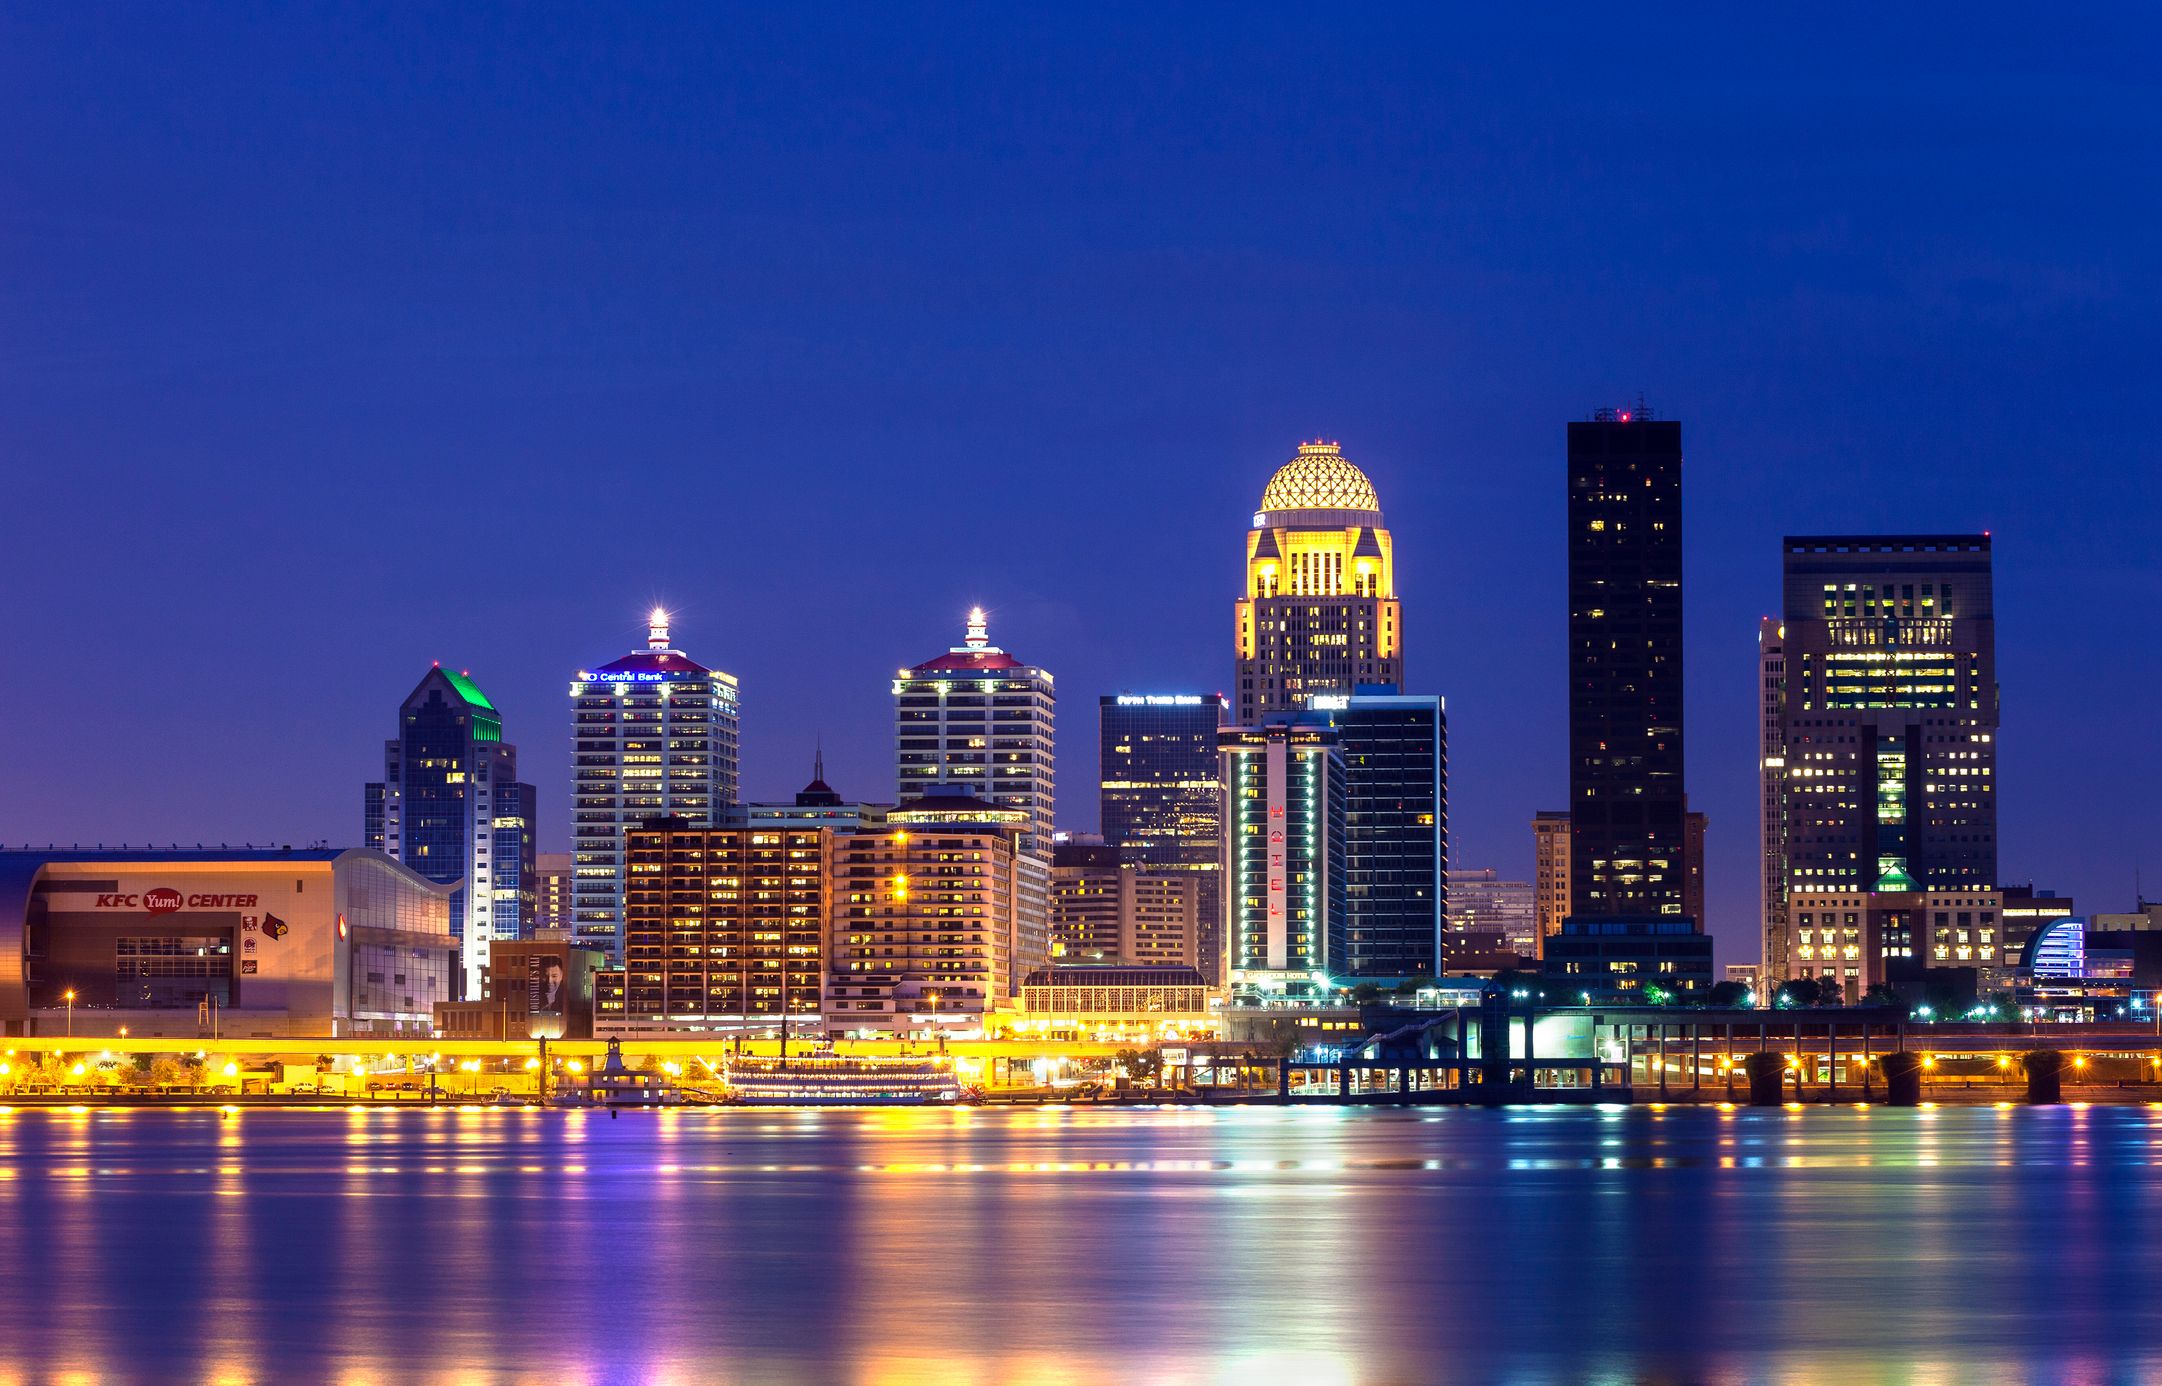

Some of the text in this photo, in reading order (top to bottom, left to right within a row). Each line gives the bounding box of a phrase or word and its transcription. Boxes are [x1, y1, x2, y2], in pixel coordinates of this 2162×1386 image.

[600, 673, 663, 682] Central Bank
[95, 894, 259, 909] KFC Yum! CENTER
[1286, 972, 1310, 980] HOTEL
[529, 970, 540, 1014] LOUISVILLE'S
